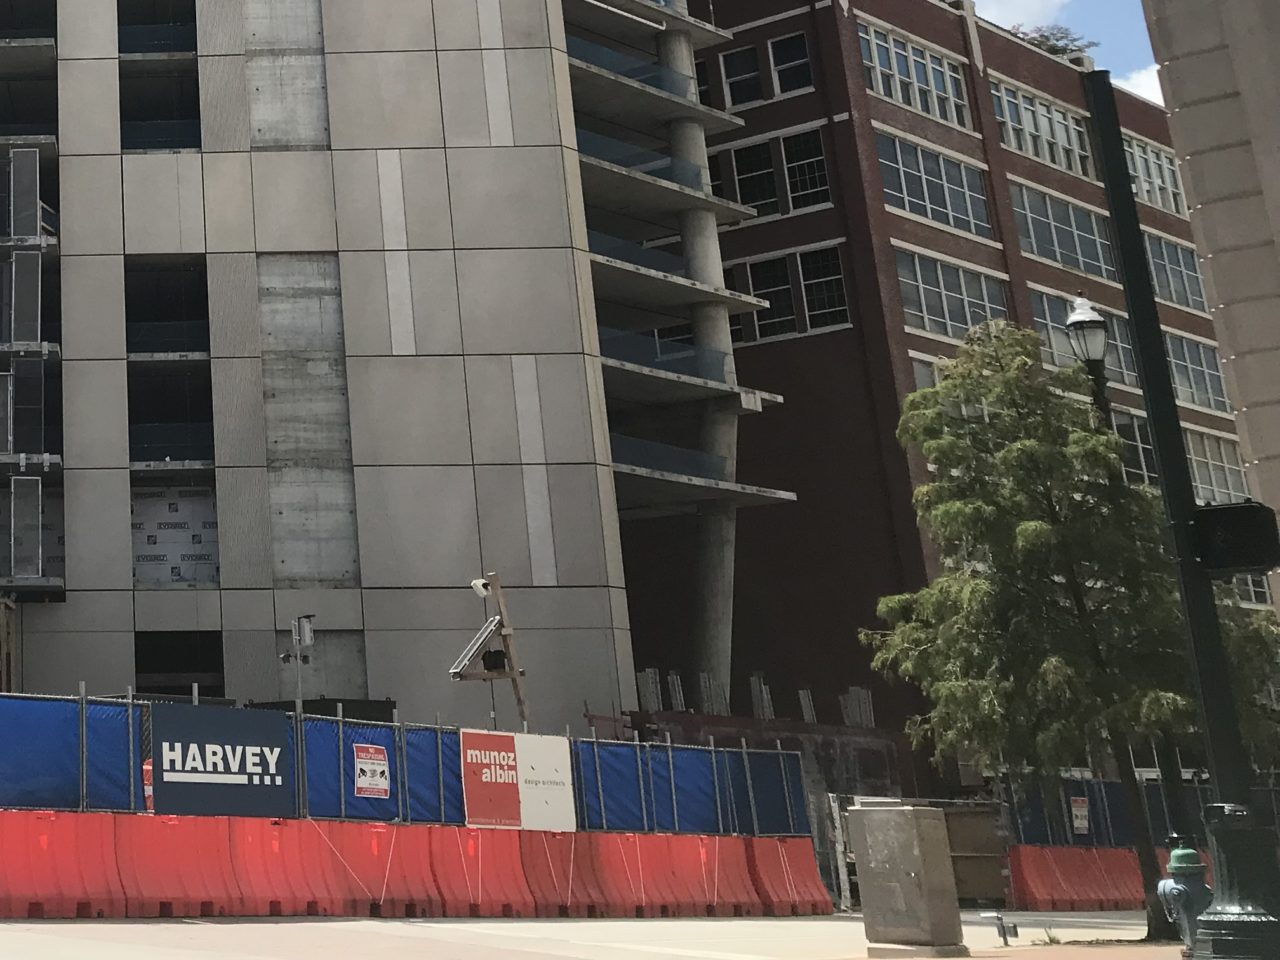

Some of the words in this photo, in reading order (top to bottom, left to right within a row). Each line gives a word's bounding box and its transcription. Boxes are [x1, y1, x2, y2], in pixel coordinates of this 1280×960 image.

[161, 741, 282, 774] HARVEY
[466, 748, 516, 766] munoz
[481, 765, 518, 784] albin
